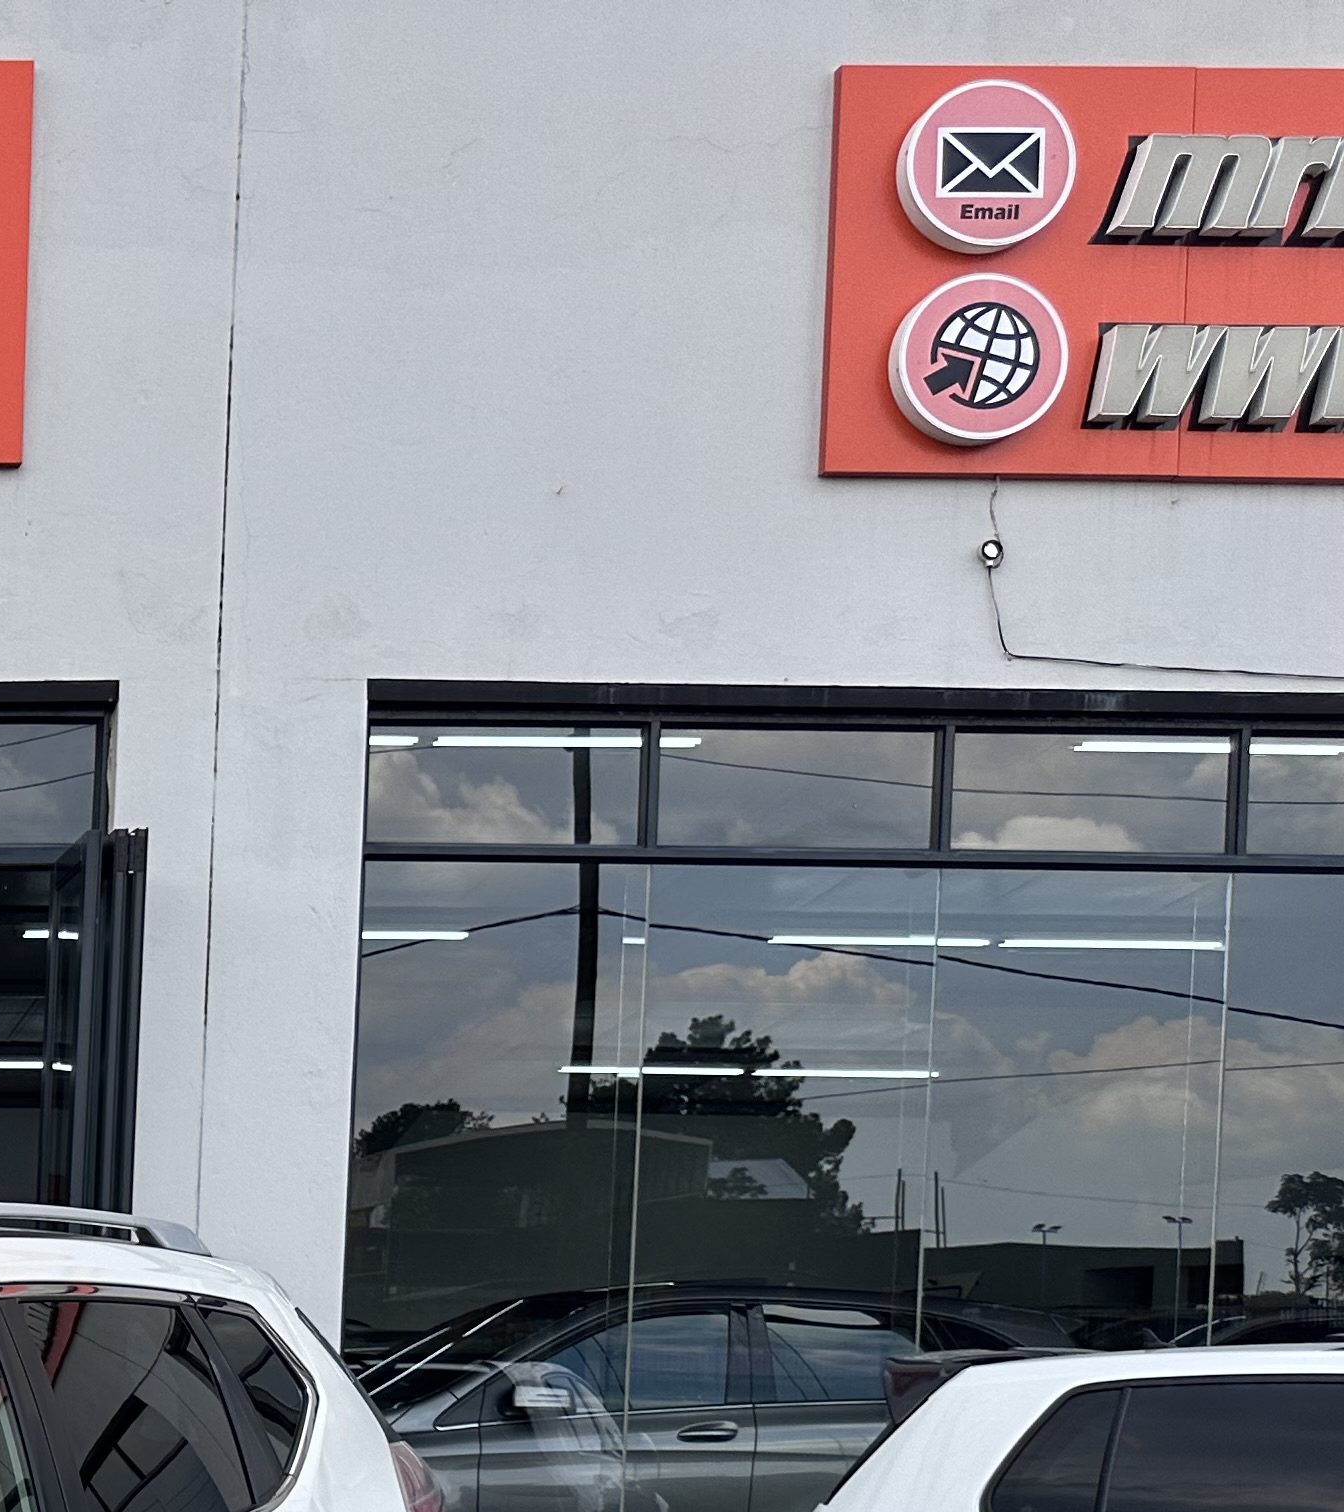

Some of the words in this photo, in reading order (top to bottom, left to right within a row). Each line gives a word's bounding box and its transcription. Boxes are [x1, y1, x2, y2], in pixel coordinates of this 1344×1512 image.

[959, 203, 1020, 221] Email
[1098, 133, 1344, 240] mr
[1088, 325, 1344, 427] ww
